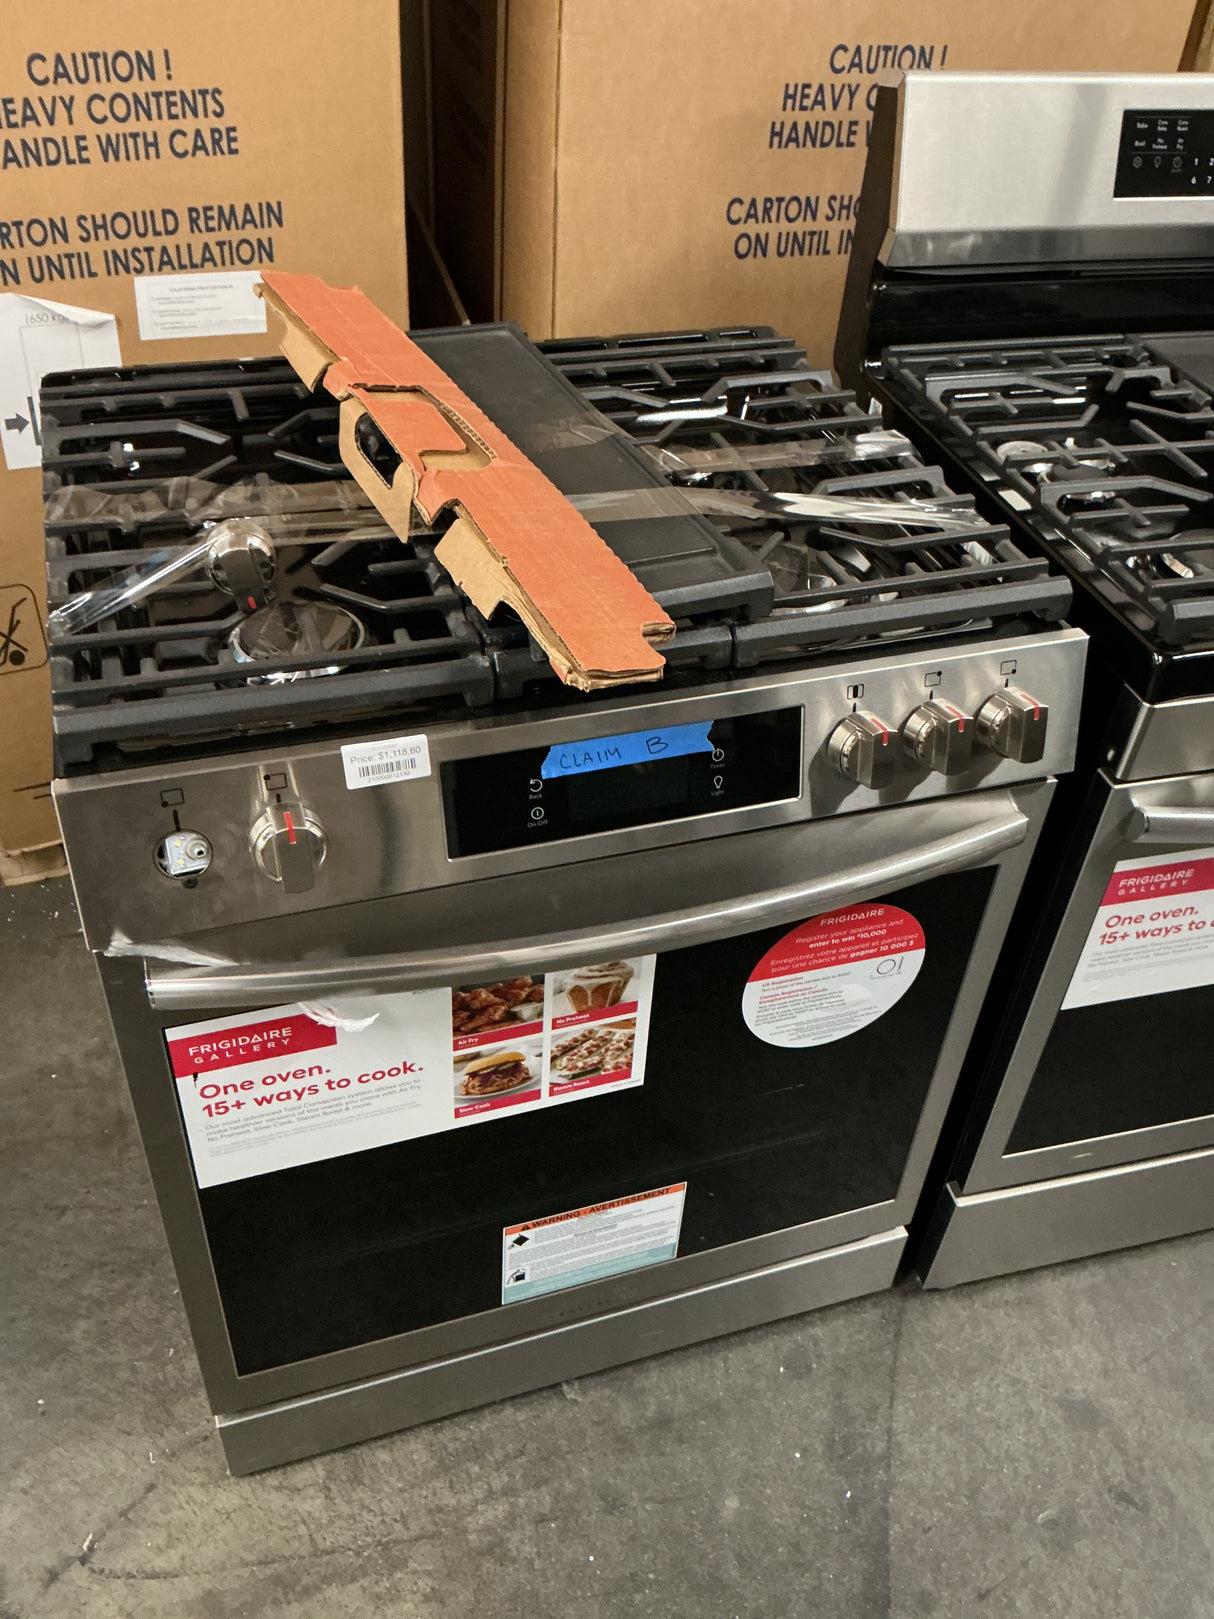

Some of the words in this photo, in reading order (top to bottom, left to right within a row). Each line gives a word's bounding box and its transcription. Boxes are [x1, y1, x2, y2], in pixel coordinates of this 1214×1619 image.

[27, 50, 156, 87] CAUTION
[164, 49, 173, 81] !
[830, 43, 934, 74] CAUTION
[0, 94, 75, 129] EAVY
[86, 88, 225, 125] CONTENTS
[782, 83, 860, 112] HEAVY
[2, 133, 91, 170] ANDLE
[97, 130, 161, 163] WITH
[169, 126, 239, 159] CARE
[768, 120, 859, 149] HANDLE
[1194, 157, 1199, 167] 1
[1191, 176, 1197, 185] 6
[1206, 175, 1213, 184] 7
[726, 195, 820, 226] CARTON
[0, 216, 70, 250] RTON
[76, 208, 179, 243] SHOULD
[189, 201, 284, 233] REMAIN
[734, 232, 769, 260] ON
[776, 230, 830, 258] UNTIL
[0, 258, 21, 287] N
[27, 251, 98, 284] UNTIL
[103, 237, 275, 276] INSTALLATION
[350, 754, 376, 765] Price:
[560, 747, 622, 770] CLAIM
[645, 736, 669, 755] B
[1117, 879, 1189, 896] GALLERY
[1118, 868, 1195, 888] FRIGIDAIRE
[820, 908, 886, 927] FRIGIDAIRE
[1104, 914, 1145, 929] One
[1149, 906, 1199, 922] oven.
[795, 933, 829, 945] Register
[829, 929, 848, 939] your
[849, 921, 888, 936] appliance
[808, 940, 830, 949] enter
[831, 937, 840, 945] to
[841, 934, 856, 943] win
[1099, 930, 1131, 946] 15+
[1135, 922, 1183, 941] ways
[1187, 919, 1206, 931] to
[770, 952, 815, 967] Enregistrez
[816, 947, 838, 957] votre
[838, 941, 871, 954] appareil
[791, 960, 808, 968] une
[808, 954, 838, 967] chance
[849, 946, 878, 959] gagner
[879, 944, 889, 952] 10
[890, 940, 907, 950] 000
[188, 1027, 292, 1056] FRIGIDAIRE
[194, 1038, 290, 1064] GALLERY
[199, 1079, 255, 1099] One
[261, 1064, 331, 1086] oven.
[202, 1100, 247, 1118] 15+
[253, 1084, 320, 1107] ways
[325, 1078, 351, 1091] to
[357, 1060, 424, 1084] cook.
[531, 1211, 581, 1228] WARNING
[589, 1187, 672, 1215] AVERTISSEMENT
